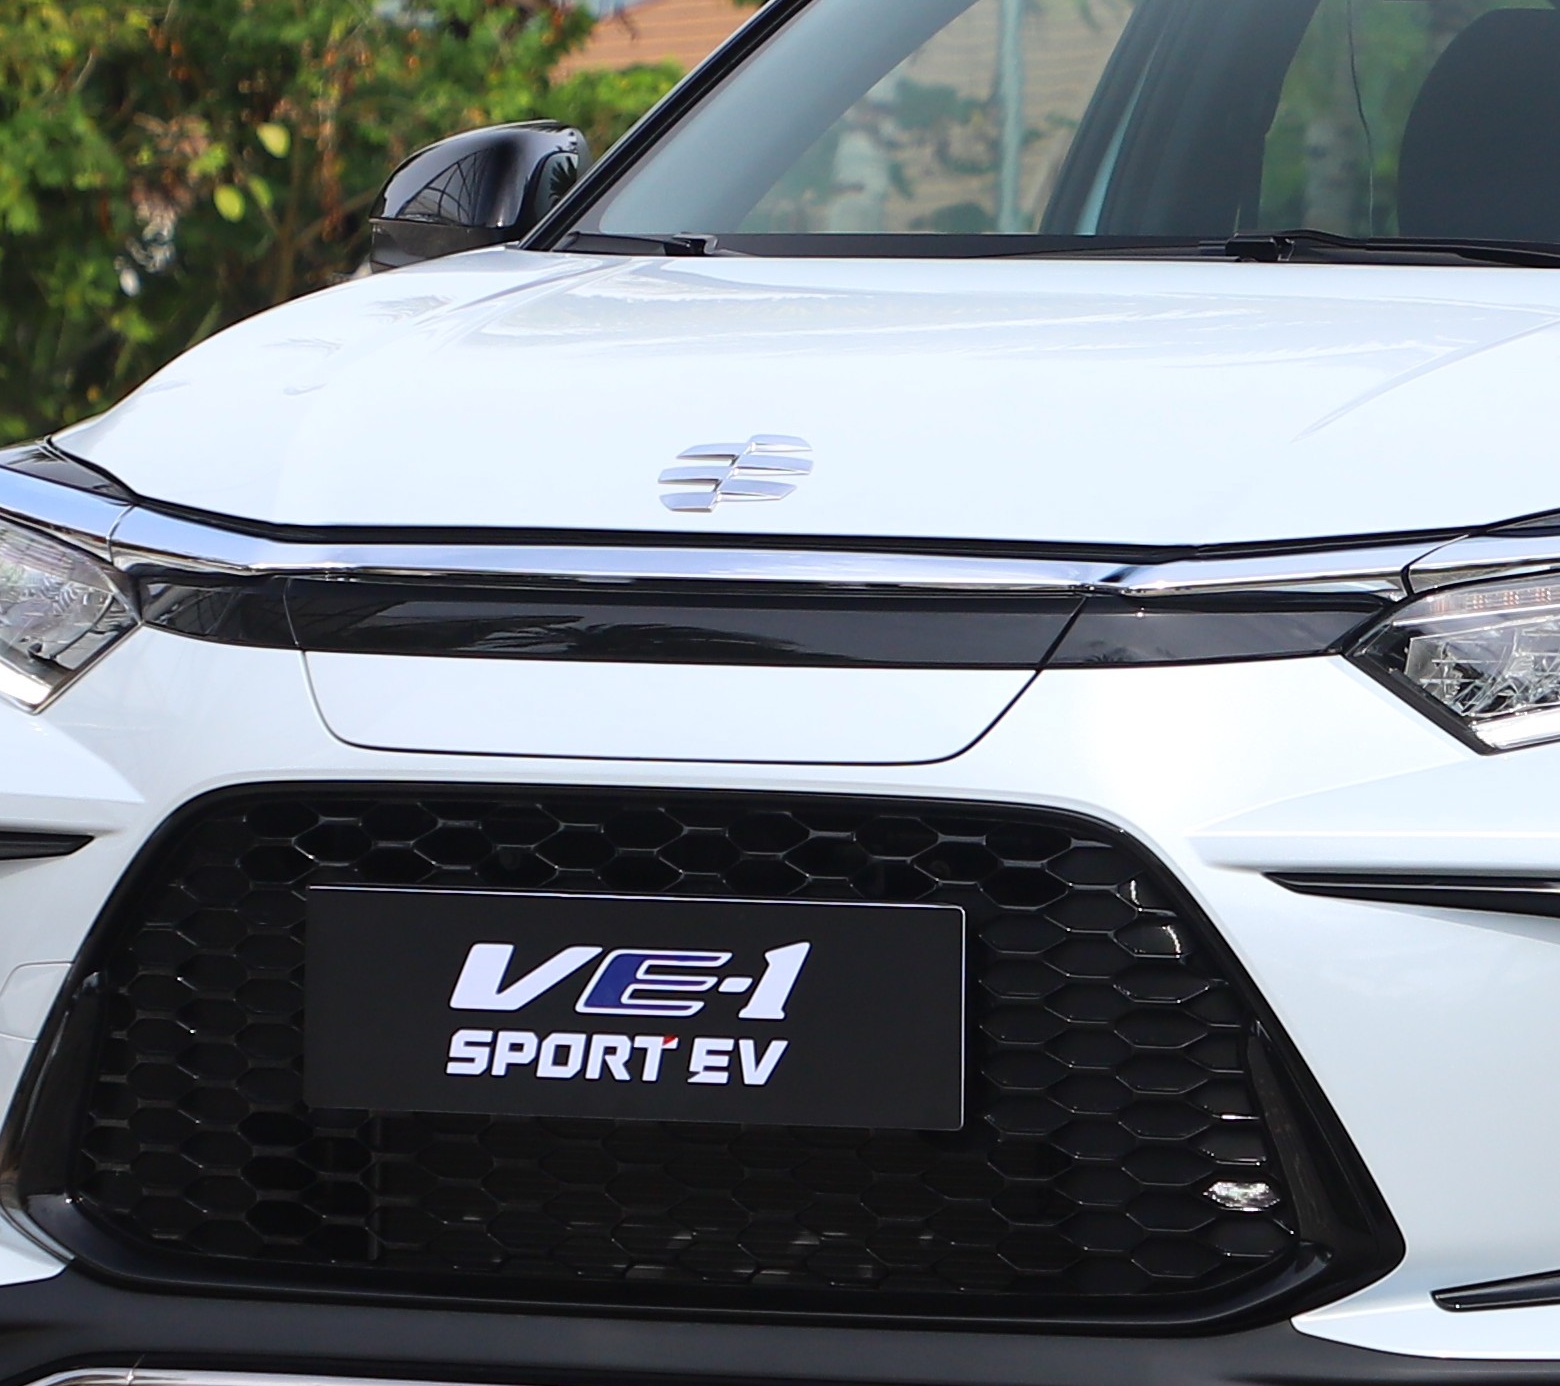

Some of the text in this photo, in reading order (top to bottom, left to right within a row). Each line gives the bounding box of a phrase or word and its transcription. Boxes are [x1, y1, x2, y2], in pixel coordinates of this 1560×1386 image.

[448, 941, 811, 1020] VE-1
[446, 1029, 788, 1085] SPORT EV
